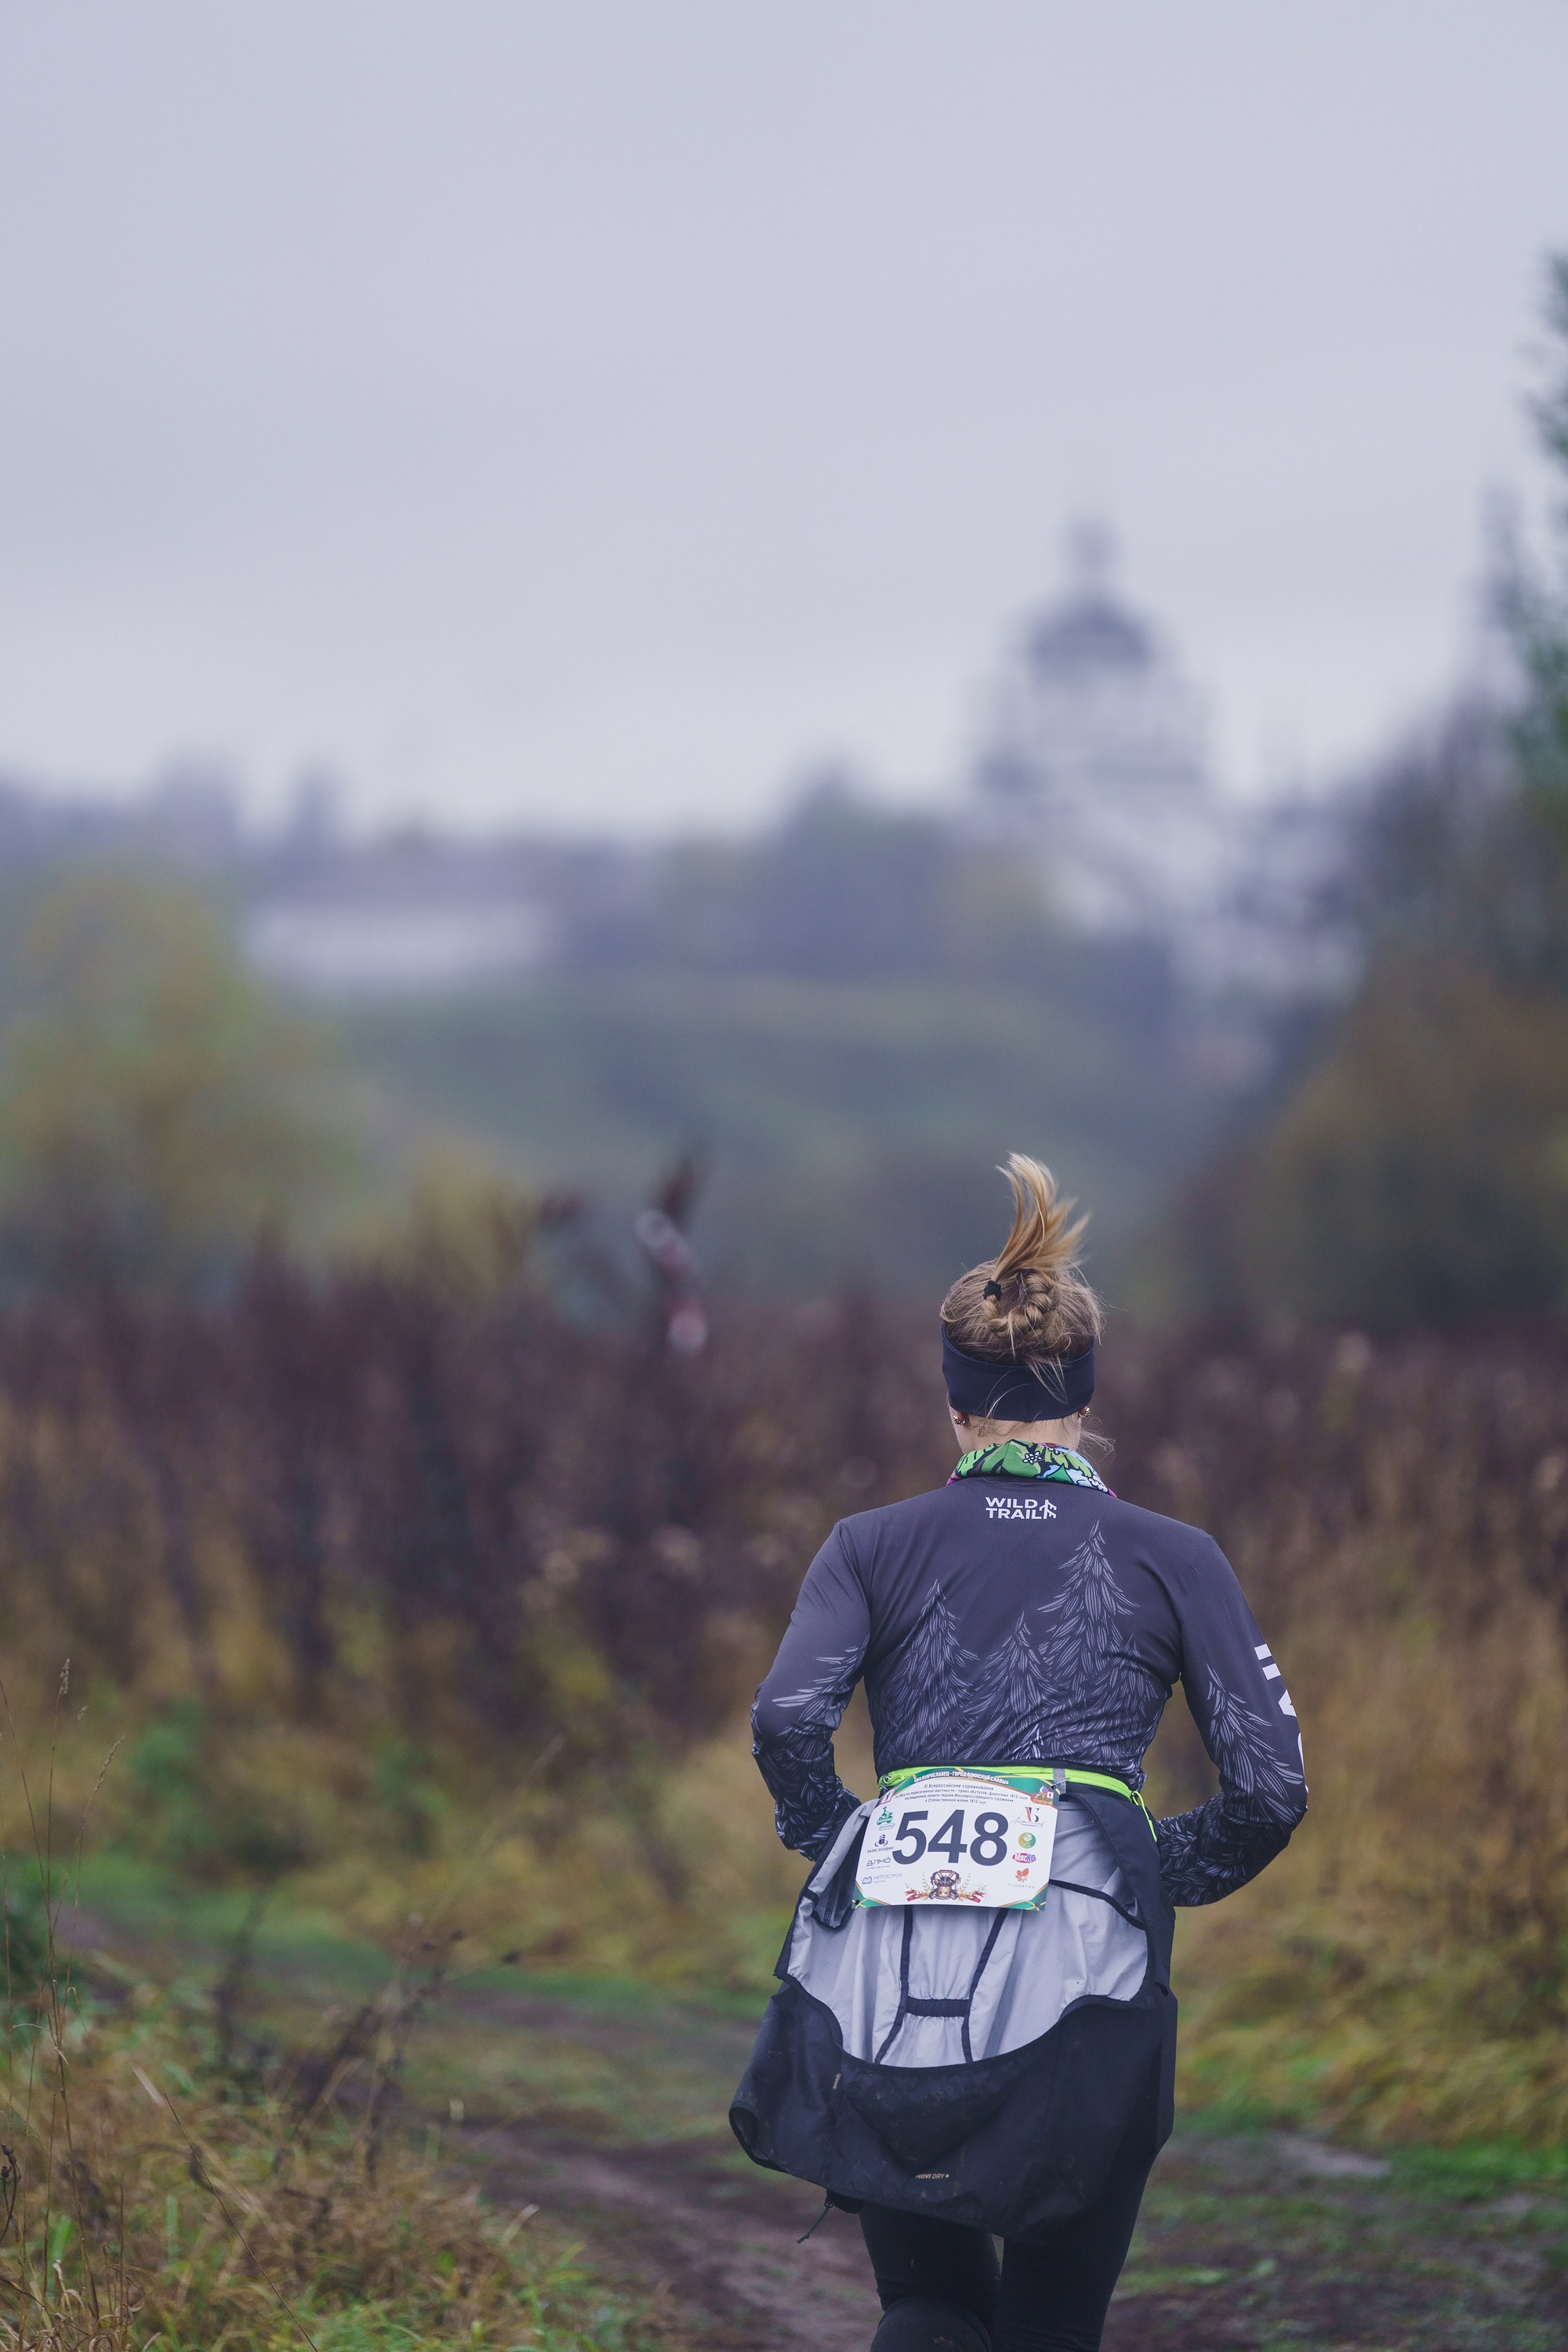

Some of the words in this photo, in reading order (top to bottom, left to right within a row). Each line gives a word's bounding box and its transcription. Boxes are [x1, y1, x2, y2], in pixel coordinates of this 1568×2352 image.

[985, 1497, 1038, 1508] WILD
[985, 1508, 1042, 1519] TRAIL
[892, 1809, 1007, 1866] 548
